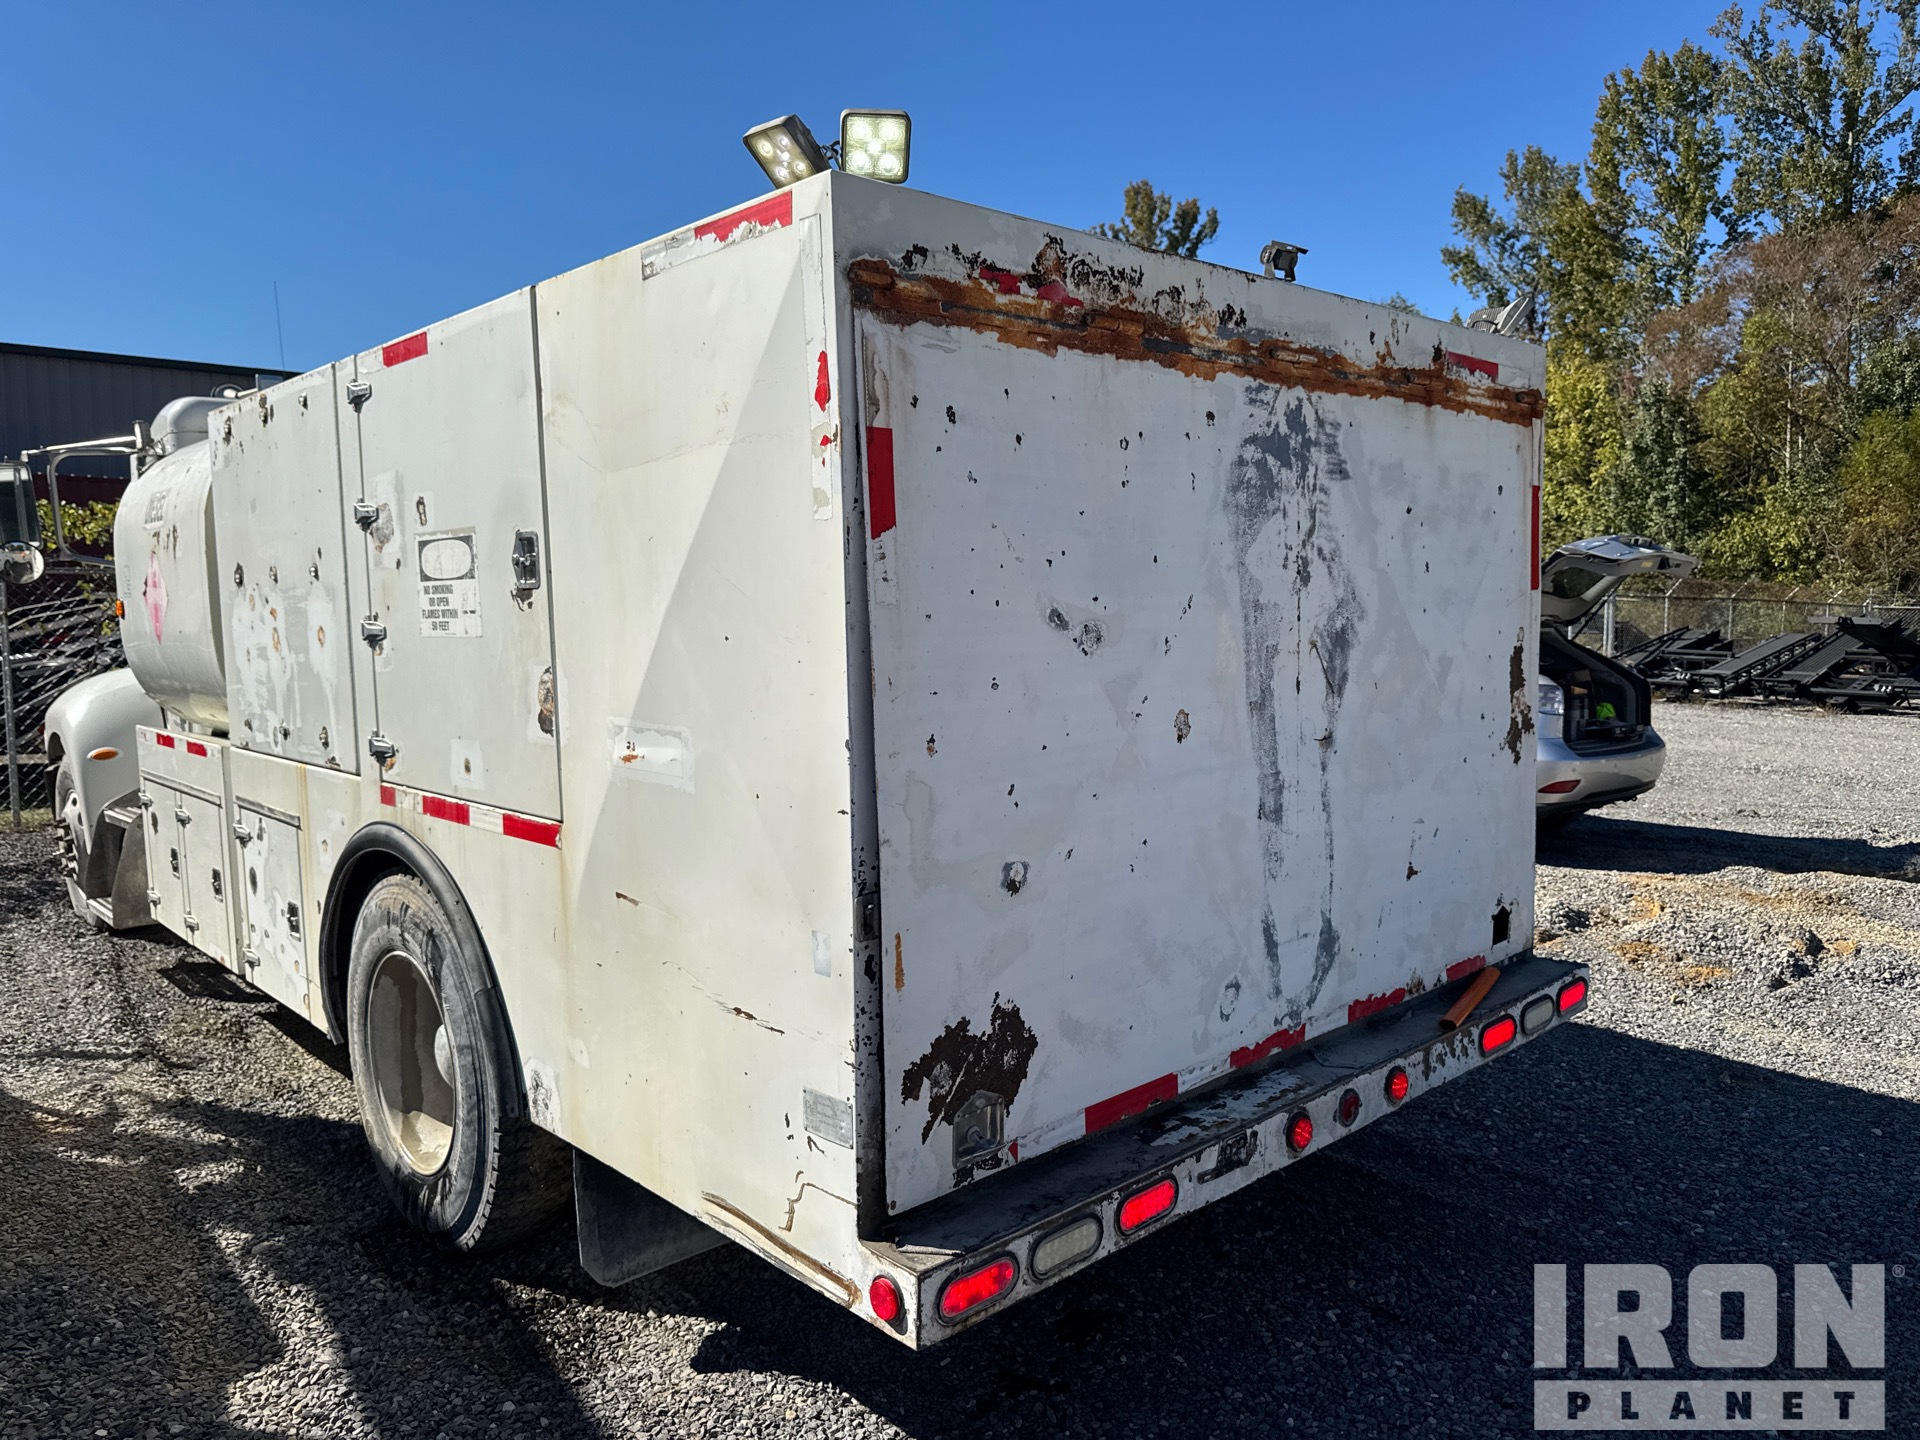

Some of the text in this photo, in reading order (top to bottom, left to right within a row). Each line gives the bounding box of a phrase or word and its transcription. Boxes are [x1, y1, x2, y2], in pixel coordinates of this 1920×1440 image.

[423, 584, 454, 595] NO SMOKING
[428, 597, 450, 607] OR OPEN
[422, 608, 459, 619] FLAMES WITHIN
[431, 621, 450, 631] 50 FEET
